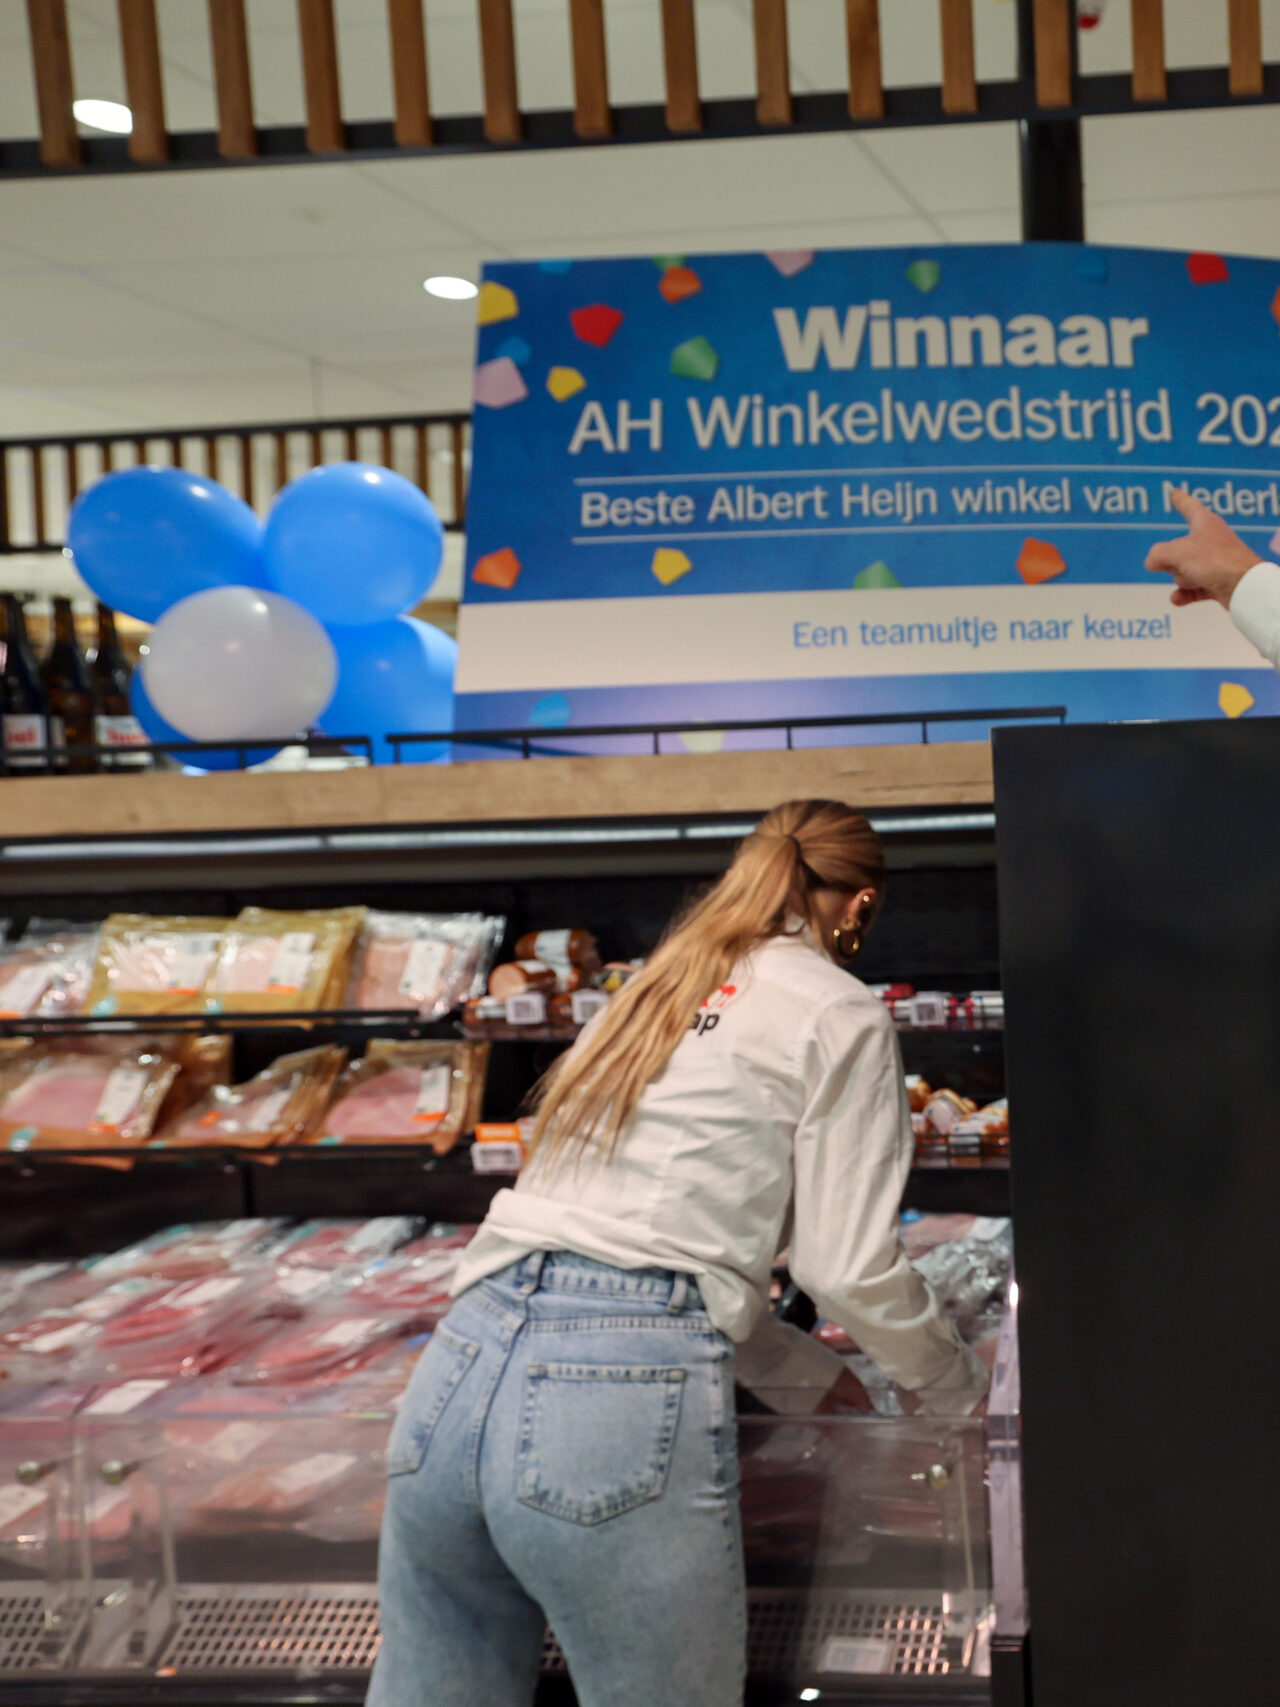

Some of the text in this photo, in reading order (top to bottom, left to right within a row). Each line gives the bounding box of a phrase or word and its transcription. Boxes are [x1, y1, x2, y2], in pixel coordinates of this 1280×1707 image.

[773, 299, 1149, 371] Winnaar
[567, 398, 663, 454] AH
[687, 386, 1172, 453] Winkelwedstrijd
[580, 491, 694, 527] Beste
[708, 485, 828, 523] Albert
[842, 482, 938, 523] Heijn
[951, 478, 1071, 514] winkel
[1084, 486, 1149, 513] van
[793, 613, 1172, 648] Een teamuitje naar keuze!
